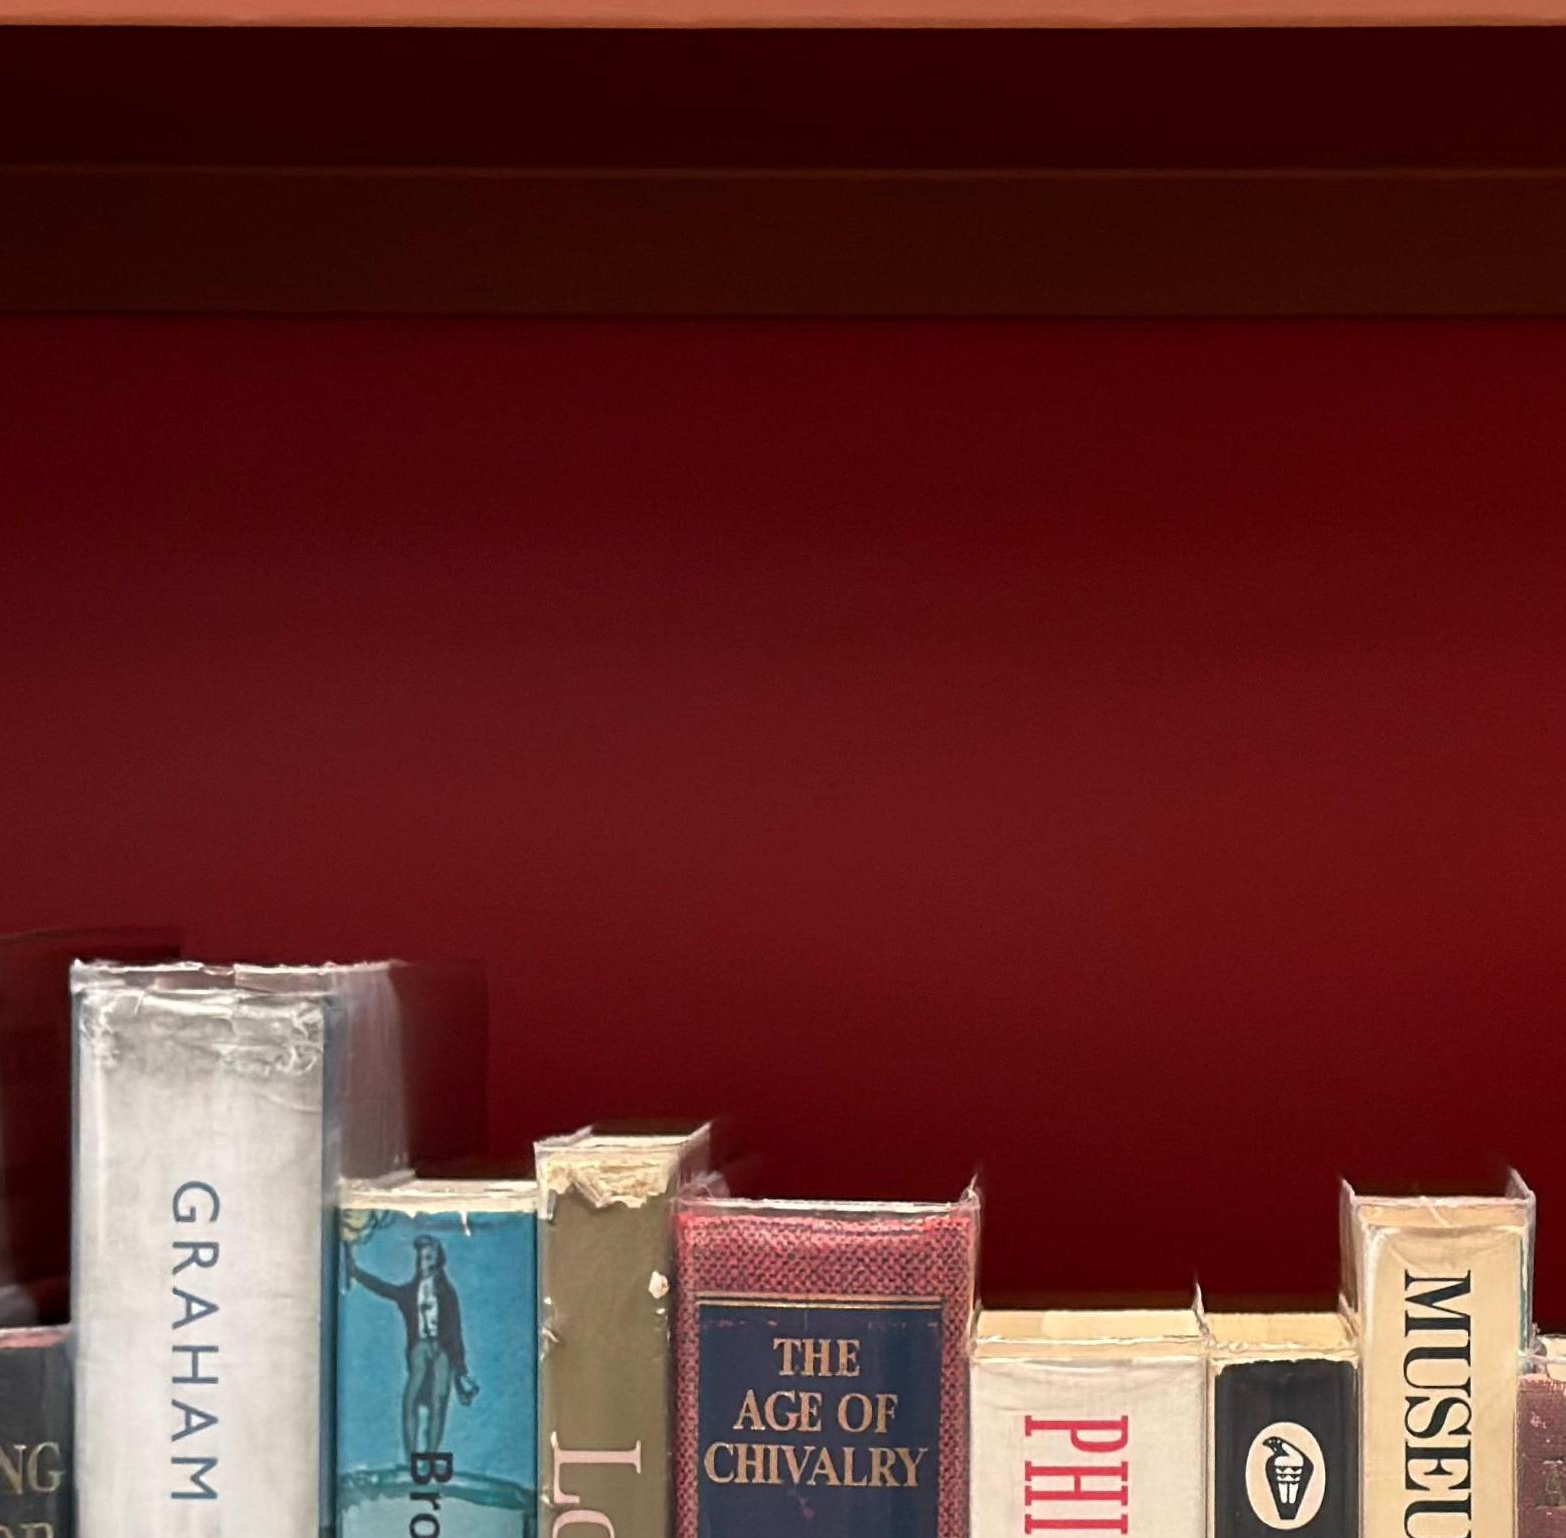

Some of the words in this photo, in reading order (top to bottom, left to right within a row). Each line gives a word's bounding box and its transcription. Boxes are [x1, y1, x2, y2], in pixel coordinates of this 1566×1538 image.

[170, 1180, 220, 1503] GRAHAM
[773, 1339, 860, 1377] THE
[734, 1390, 822, 1433] AGE
[838, 1393, 898, 1433] OF
[704, 1445, 928, 1488] CHIVALRY
